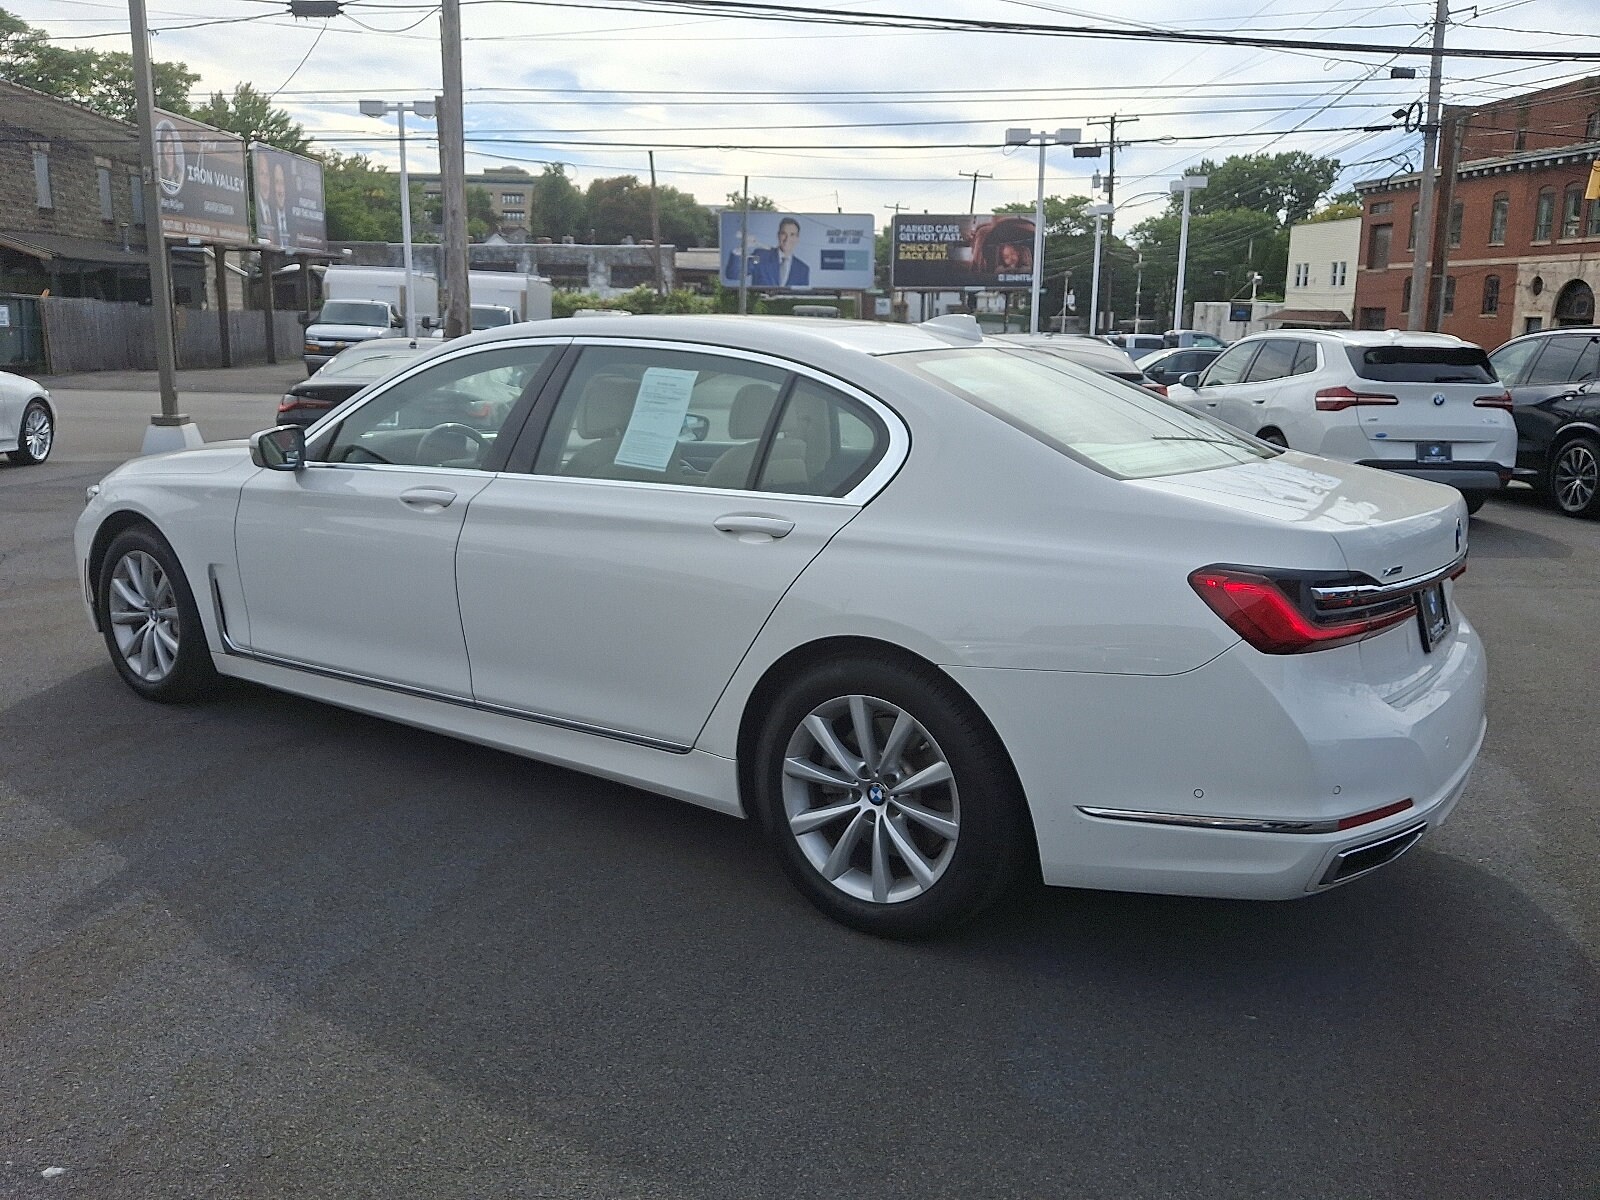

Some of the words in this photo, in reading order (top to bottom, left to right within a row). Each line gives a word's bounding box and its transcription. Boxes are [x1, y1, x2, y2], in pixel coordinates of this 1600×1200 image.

[187, 164, 213, 185] IRON
[214, 171, 244, 193] VALLEY
[899, 224, 934, 233] PARKED
[935, 224, 960, 233] CARS
[899, 232, 916, 241] GET
[917, 232, 938, 242] HOT,
[939, 232, 964, 241] FAST.
[899, 243, 929, 252] CHECK
[932, 243, 948, 252] THE
[899, 251, 924, 260] BACK
[925, 251, 949, 260] SEAT.
